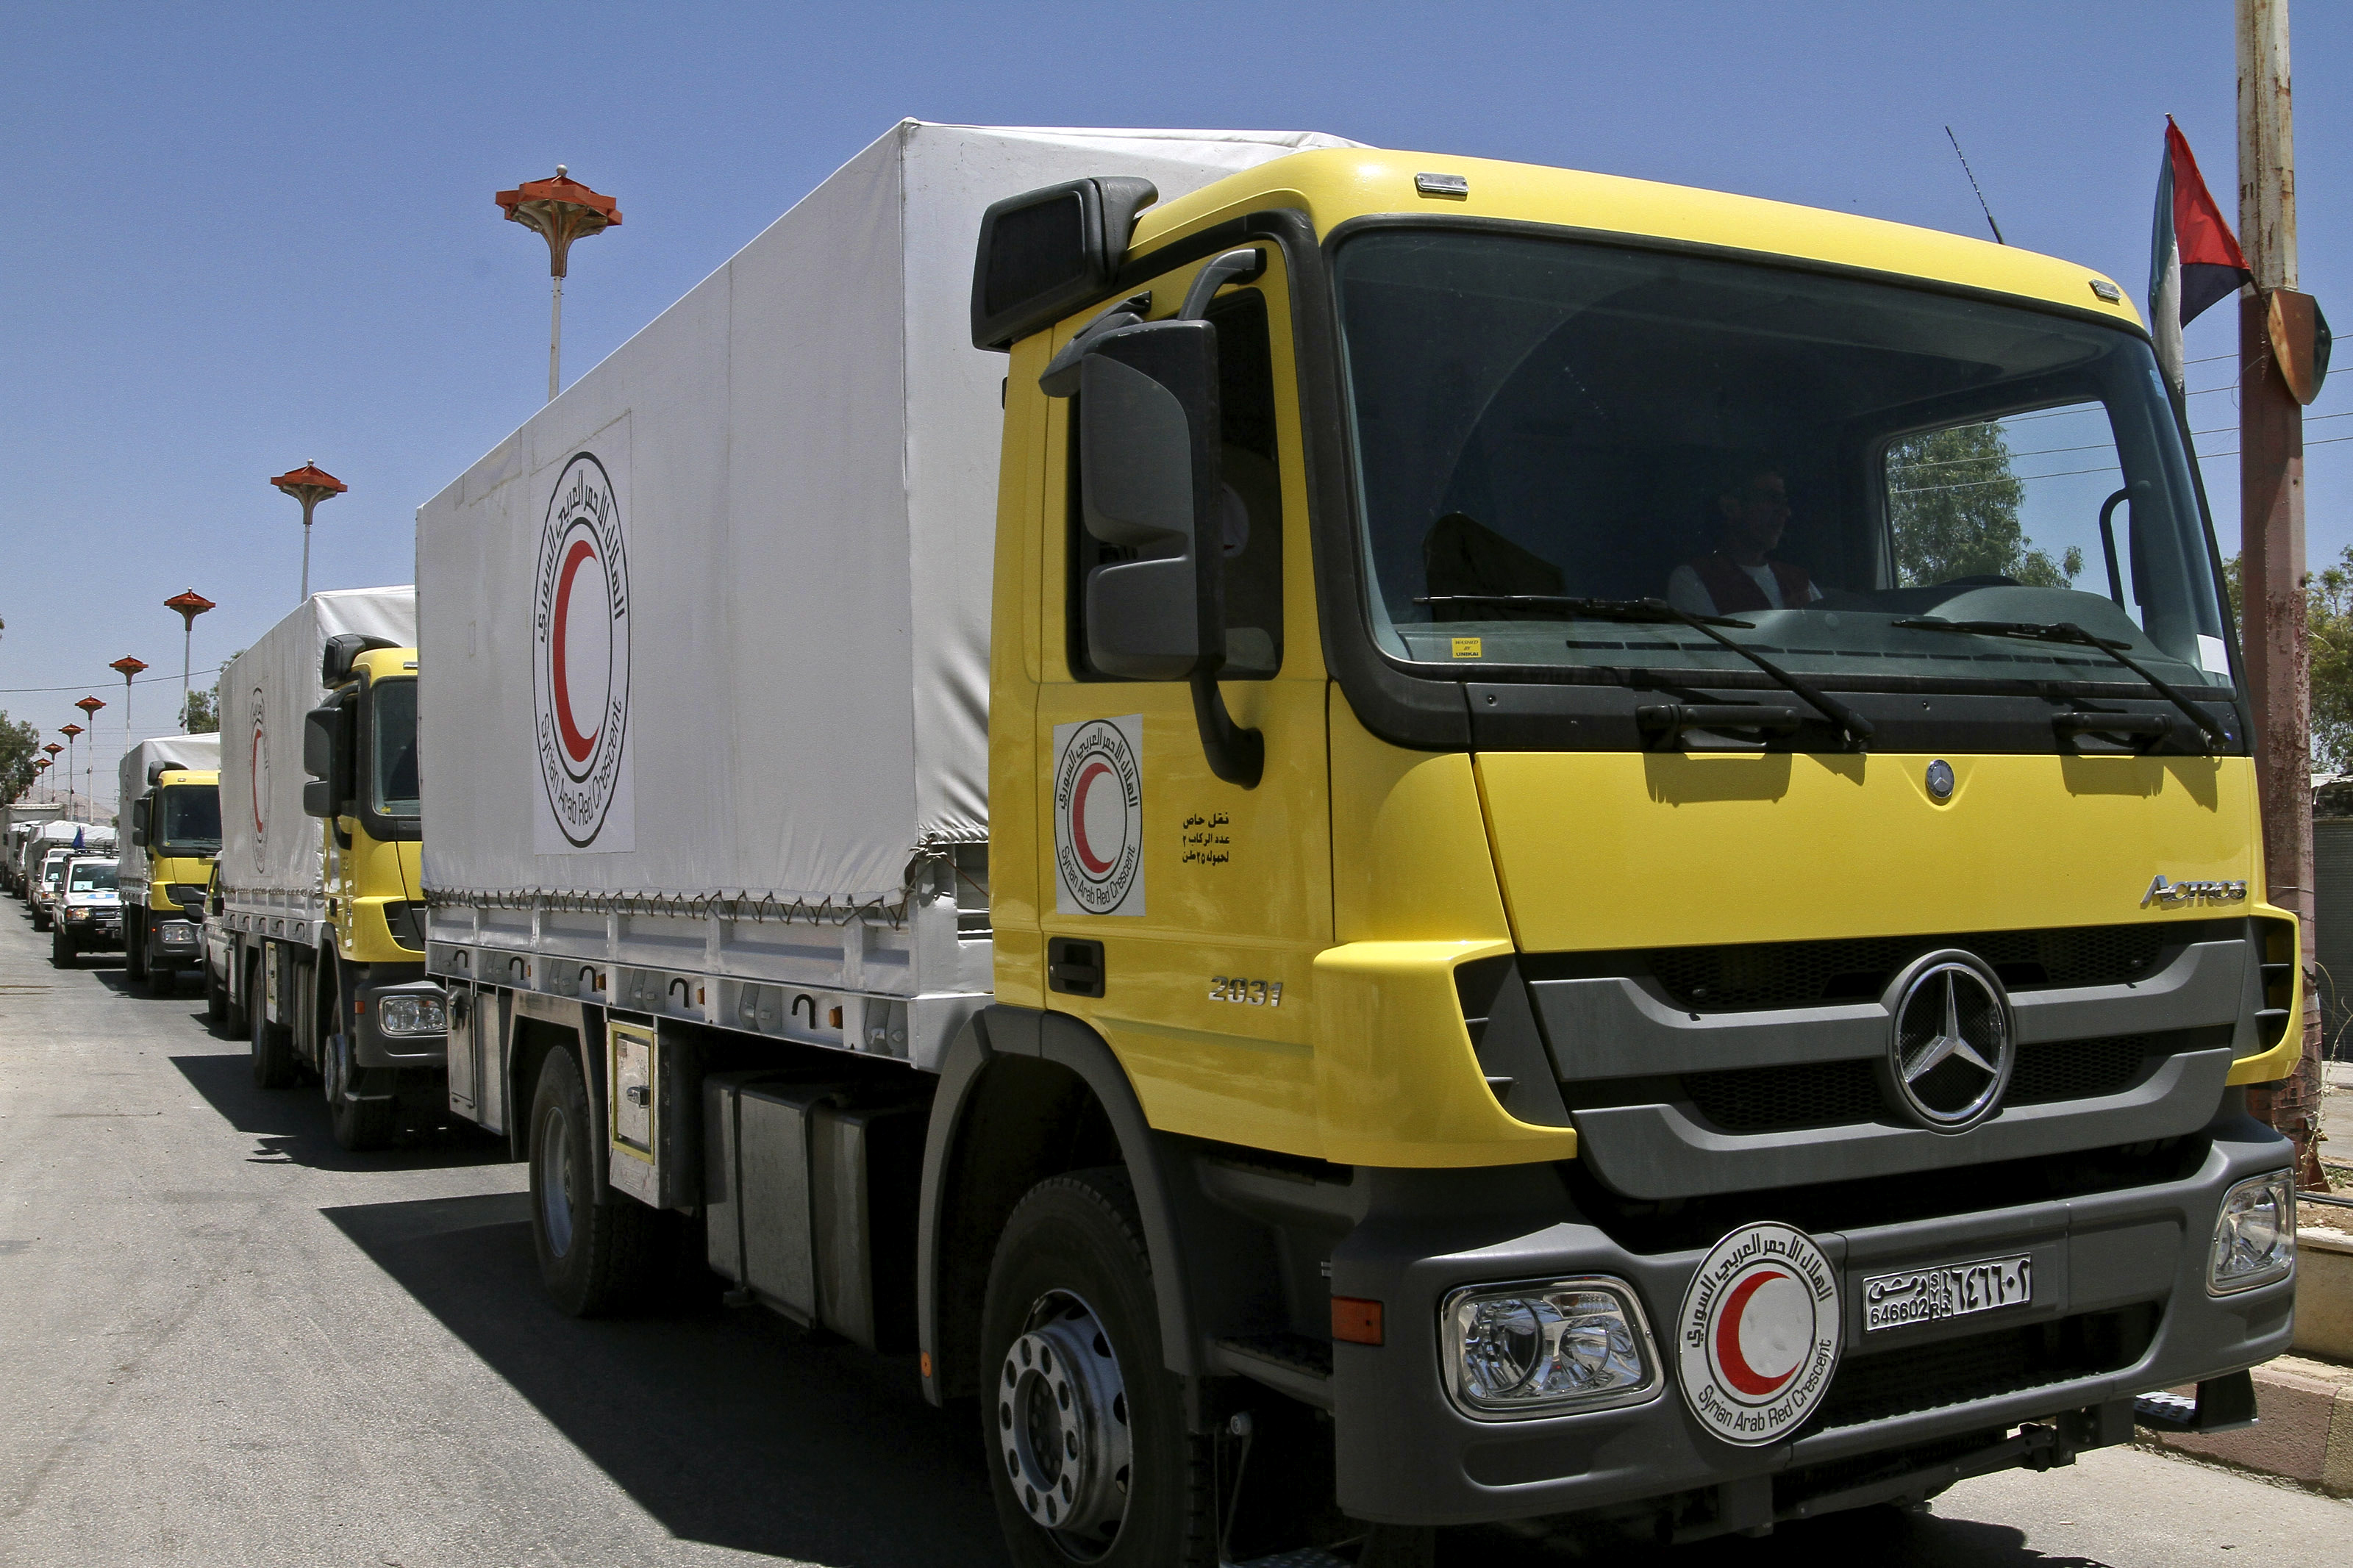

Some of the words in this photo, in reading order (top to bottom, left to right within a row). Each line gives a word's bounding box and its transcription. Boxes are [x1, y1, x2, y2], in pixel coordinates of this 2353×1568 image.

[541, 712, 560, 794] Syrian
[558, 777, 576, 825] Arab
[578, 785, 593, 826] Red
[593, 695, 622, 810] Crescent
[1061, 845, 1079, 888] Syrian
[1077, 879, 1095, 904] Arab
[1096, 885, 1110, 906] Red
[1110, 844, 1135, 898] Crescent
[1208, 976, 1284, 1008] 2031
[1715, 1233, 1760, 1281] العربي
[1799, 1253, 1833, 1302] الهلال
[1687, 1274, 1716, 1348] السوري
[1871, 1297, 1929, 1325] 646602
[1699, 1384, 1732, 1427] Syrian
[1733, 1411, 1765, 1432] Arab
[1768, 1398, 1793, 1428] Red
[1792, 1339, 1832, 1408] Crescent
